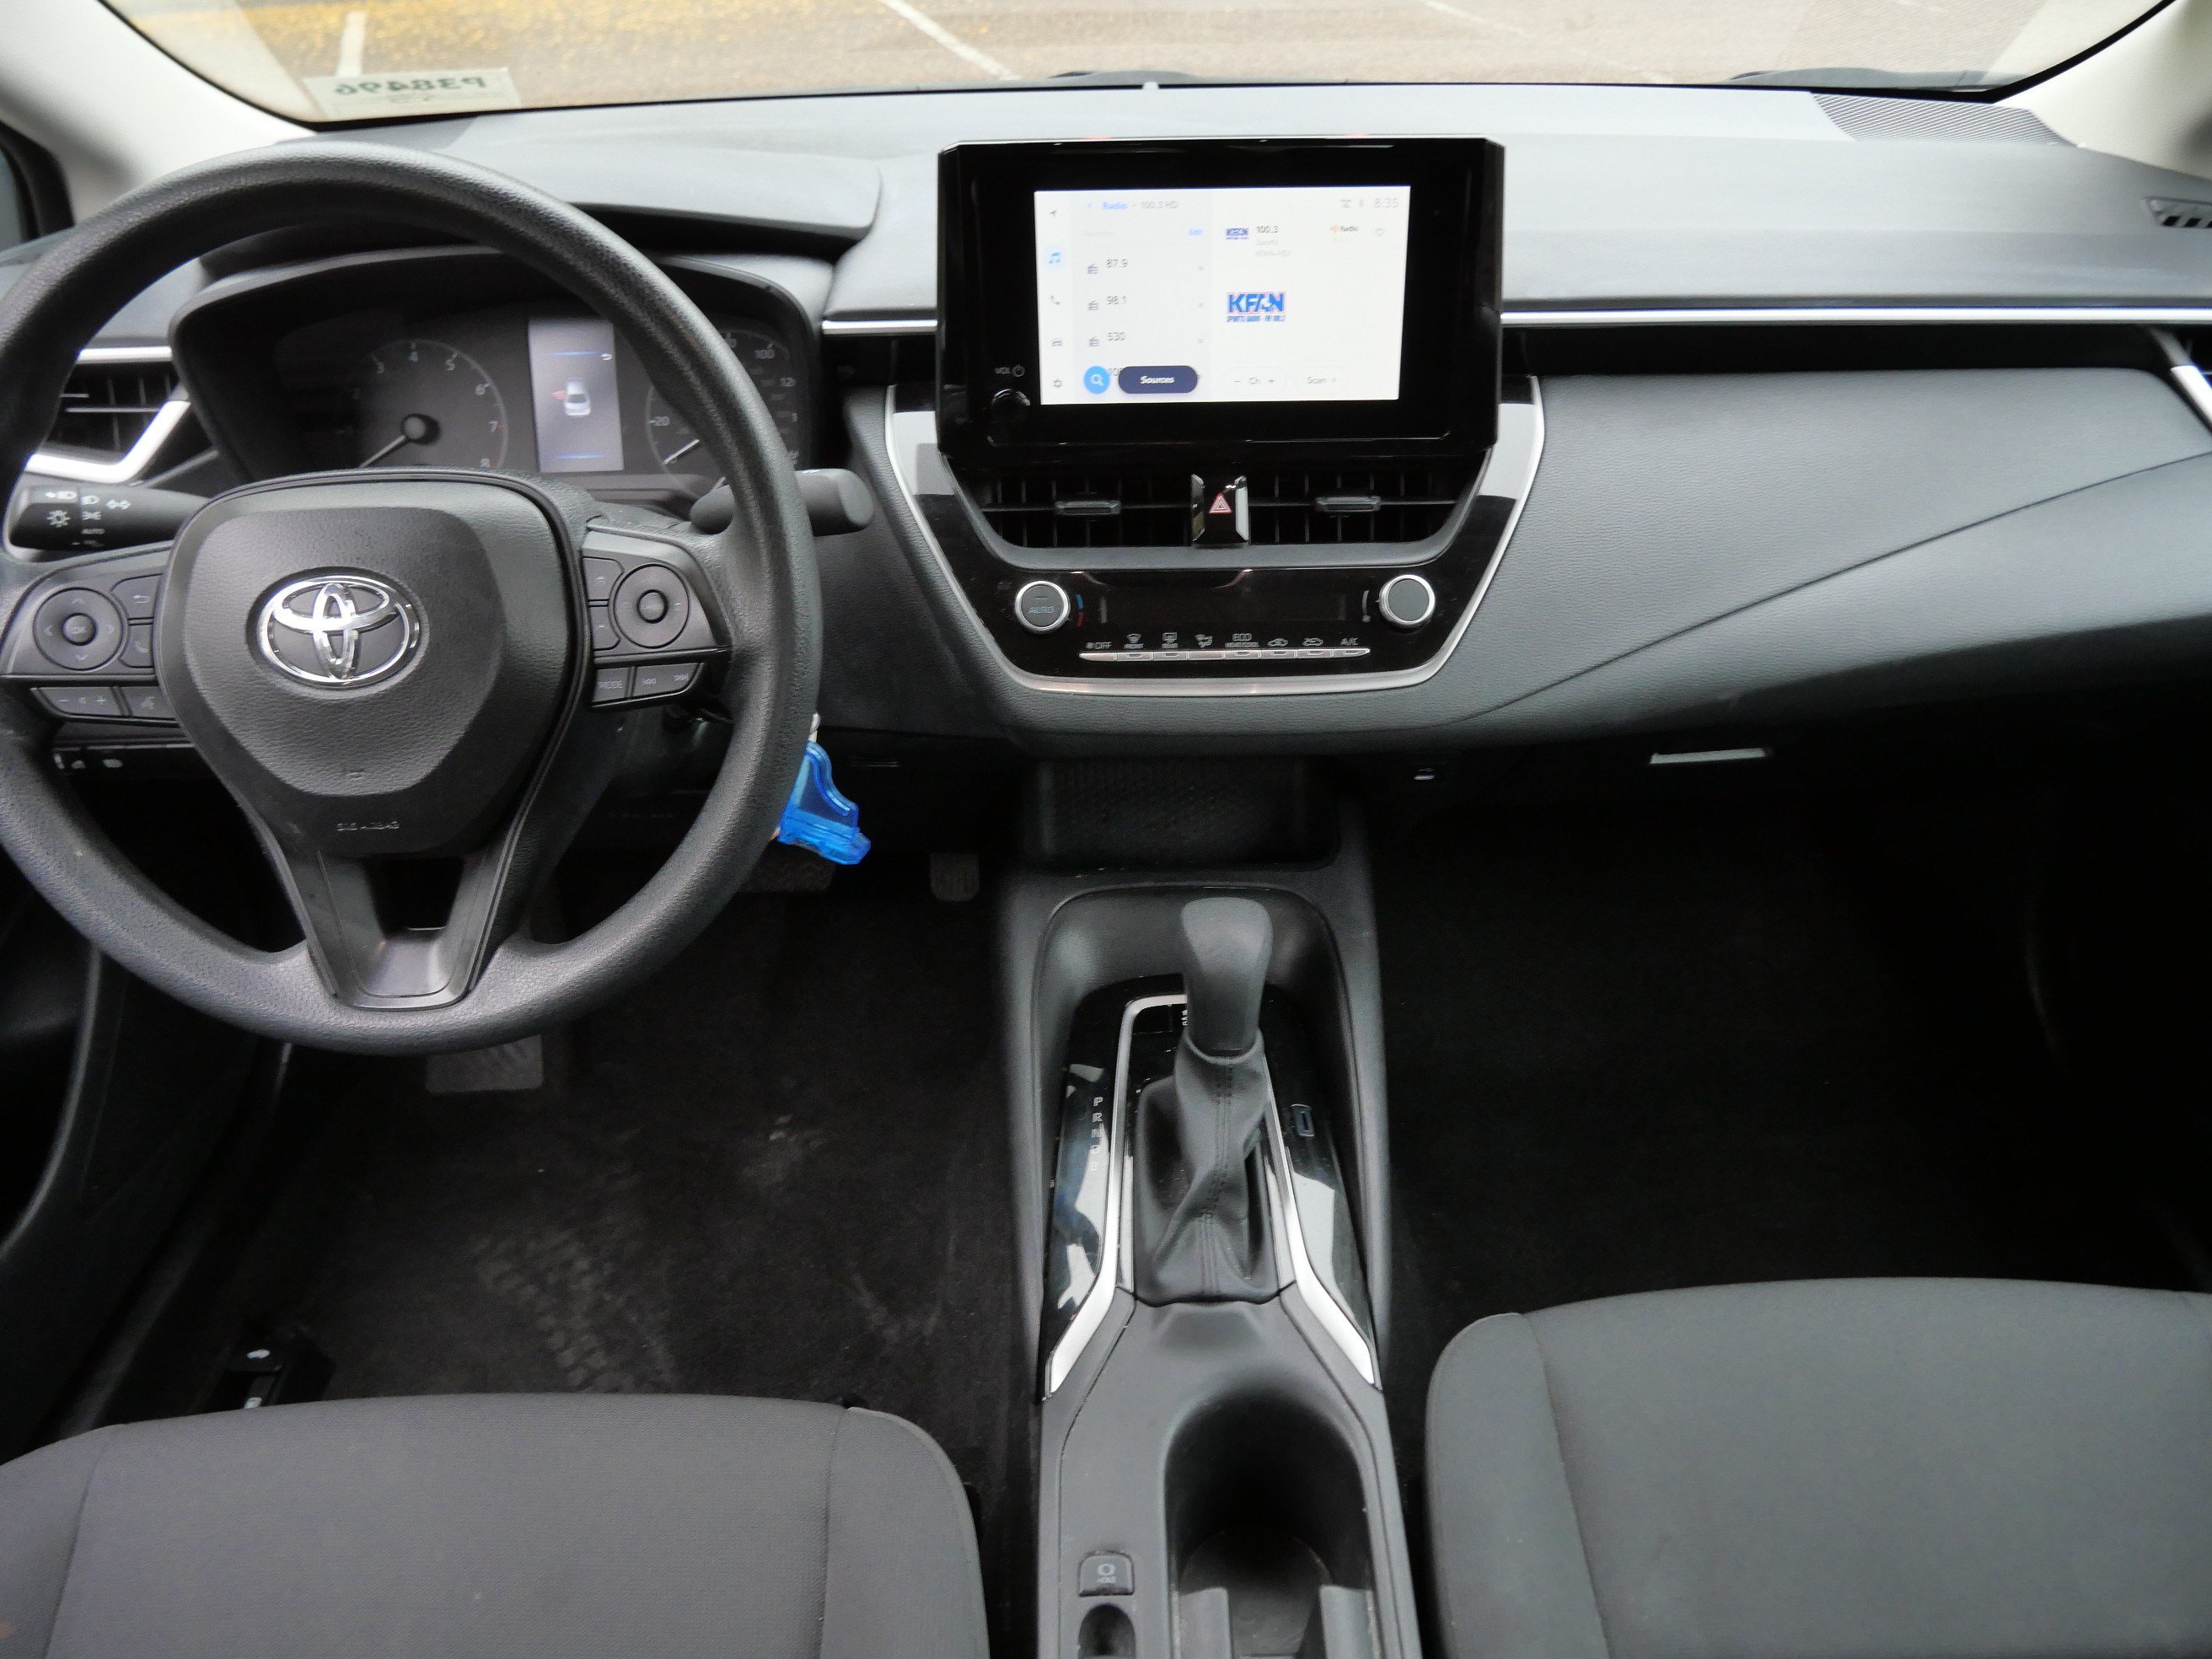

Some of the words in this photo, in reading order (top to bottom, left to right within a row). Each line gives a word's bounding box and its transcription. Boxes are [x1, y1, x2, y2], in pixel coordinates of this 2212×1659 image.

[1102, 201, 1128, 211] Radio
[1106, 258, 1129, 268] 87.9
[1107, 295, 1127, 305] 98.1
[1227, 292, 1286, 314] KFAN
[1107, 331, 1126, 341] 530
[1140, 375, 1175, 384] Sources
[1093, 1096, 1103, 1107] P
[1092, 1112, 1103, 1123] R
